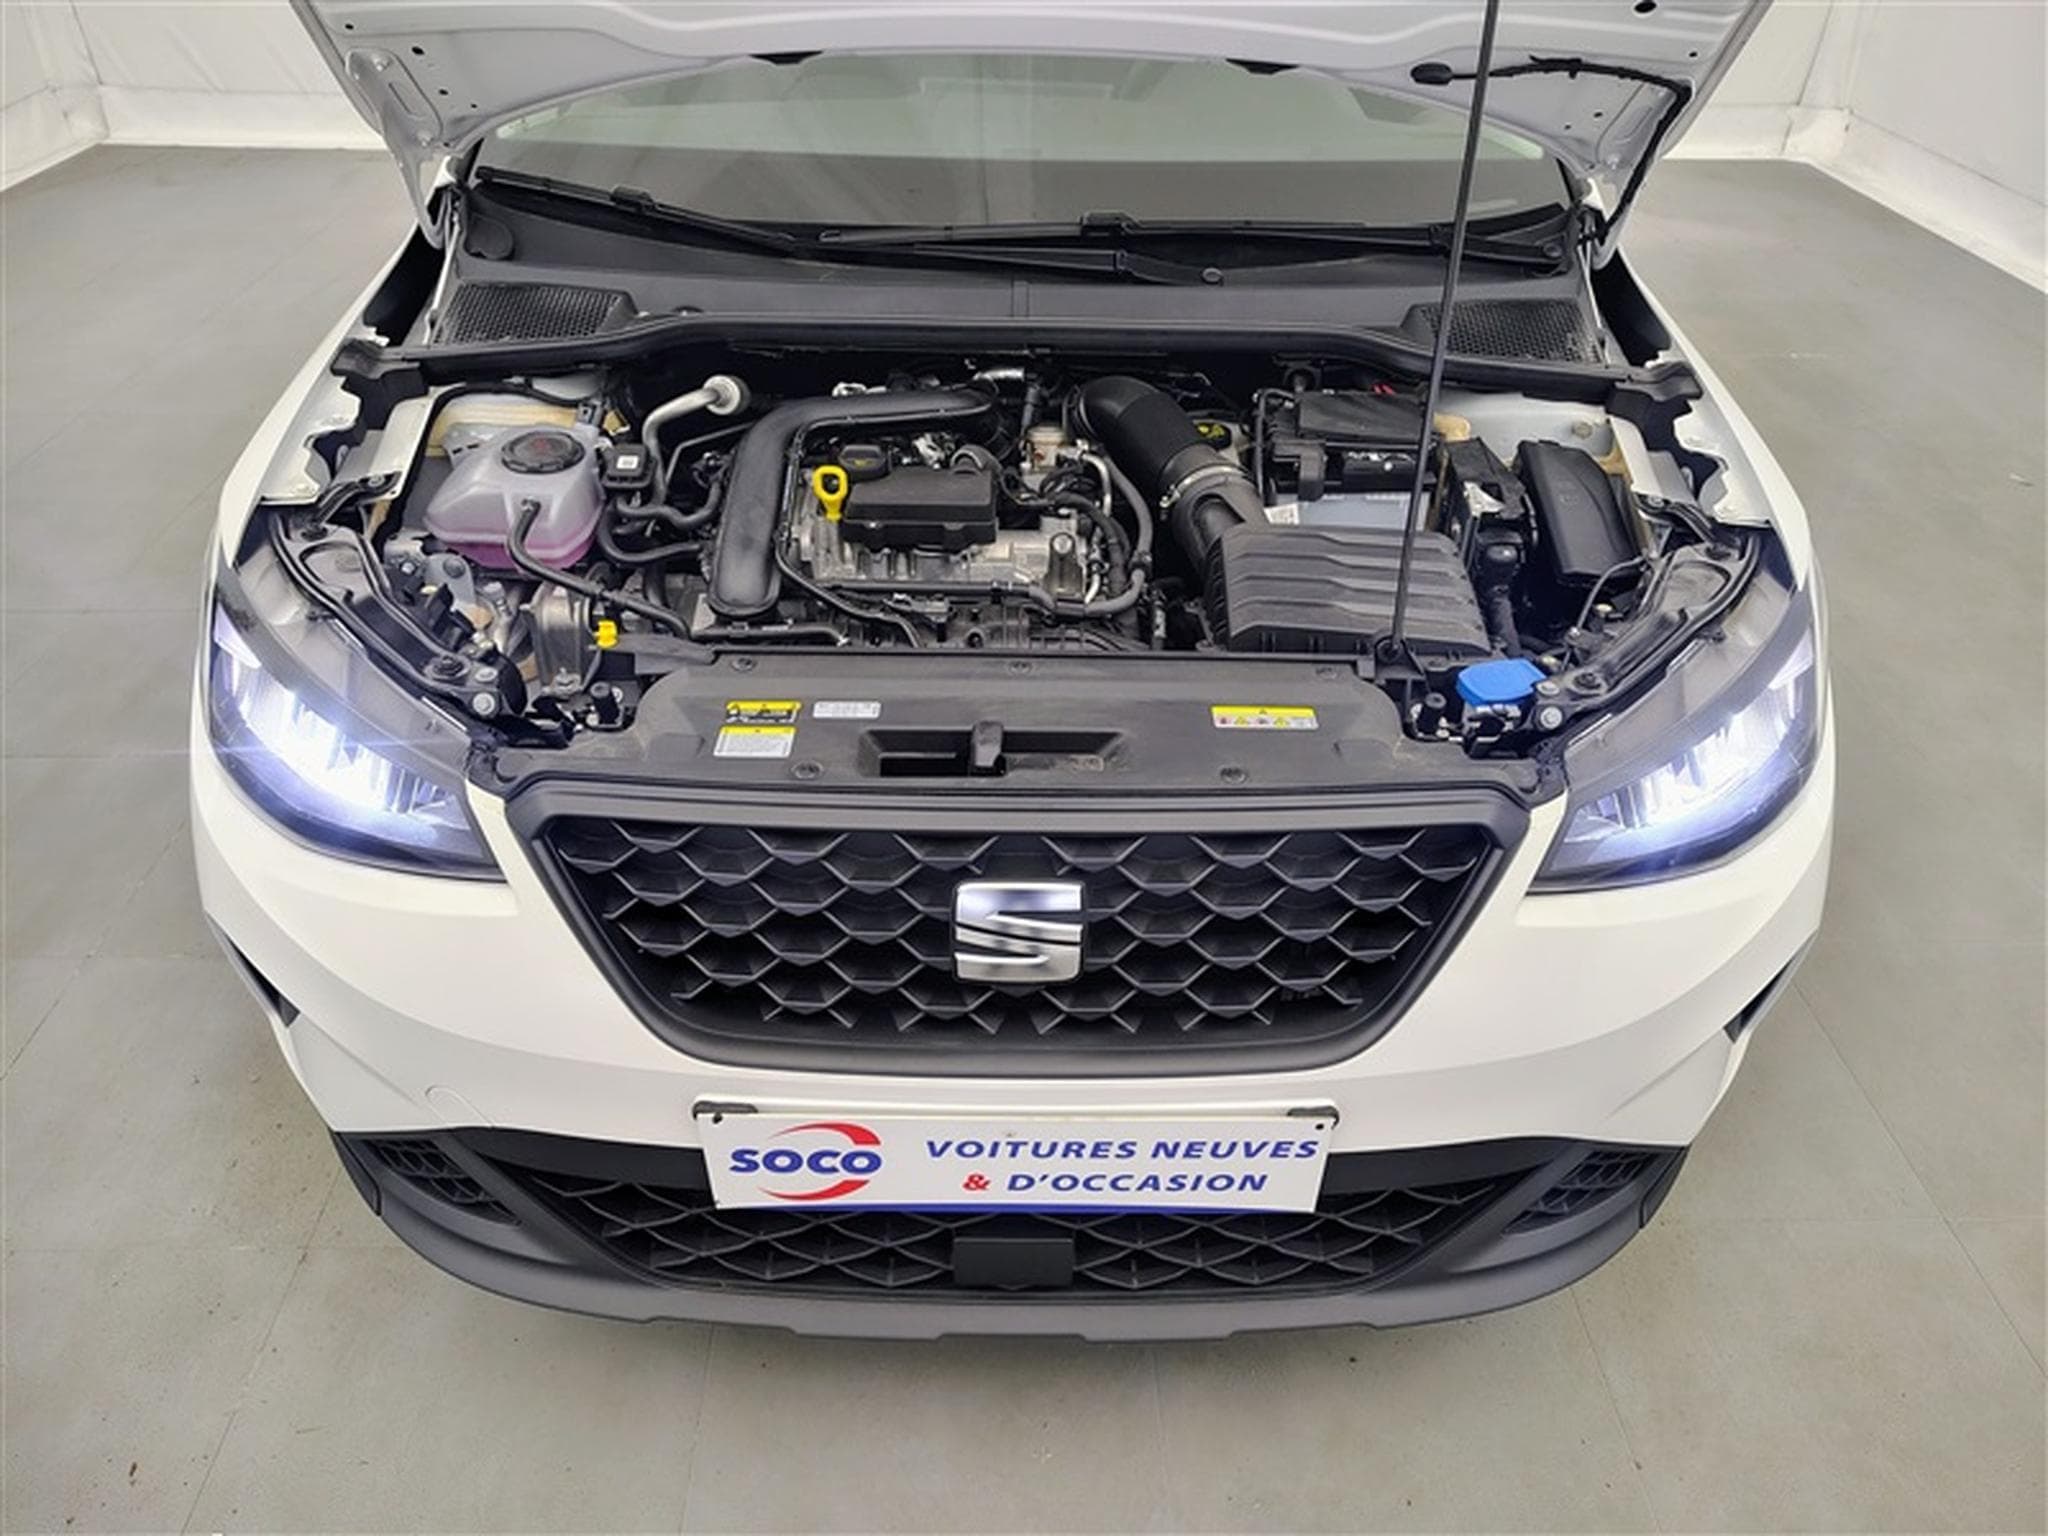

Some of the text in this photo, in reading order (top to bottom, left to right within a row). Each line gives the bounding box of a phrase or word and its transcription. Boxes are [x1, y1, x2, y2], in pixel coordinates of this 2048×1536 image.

[926, 1140, 1319, 1159] VOITURES NEUVES
[729, 1148, 882, 1174] SOCO
[962, 1173, 1268, 1192] & D'OCCASION
